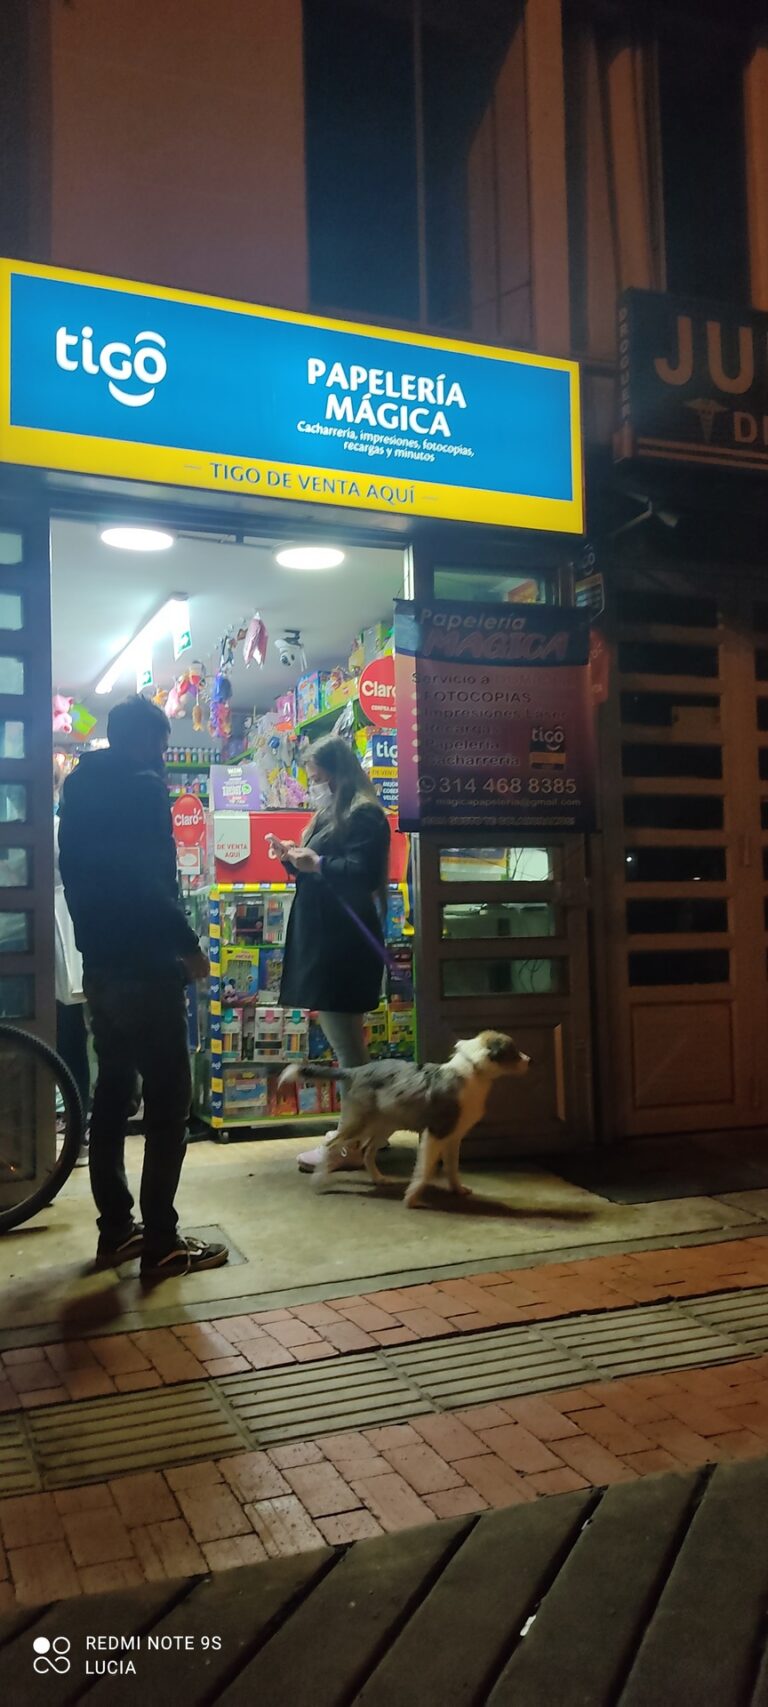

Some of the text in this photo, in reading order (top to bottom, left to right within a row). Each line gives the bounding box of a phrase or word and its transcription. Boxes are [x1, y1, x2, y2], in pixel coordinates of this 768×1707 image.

[55, 326, 167, 407] tigo
[654, 315, 768, 394] JU
[307, 358, 467, 408] PAPELERÍA
[325, 393, 451, 437] MÁGICA
[733, 411, 768, 446] D
[343, 440, 435, 462] recargas y minutos
[360, 430, 421, 450] impresiones,
[422, 439, 475, 458] fotocopias,
[209, 462, 415, 505] TIGO DE VENTA AQUÍ
[411, 672, 476, 685] Servicio
[480, 675, 490, 685] a
[424, 691, 532, 704] FOTOCOPIAS
[424, 708, 520, 721] Impresiones
[531, 726, 565, 751] tigo
[376, 741, 398, 766] tig
[439, 777, 577, 794] 314 468 8385
[174, 812, 199, 827] Claro
